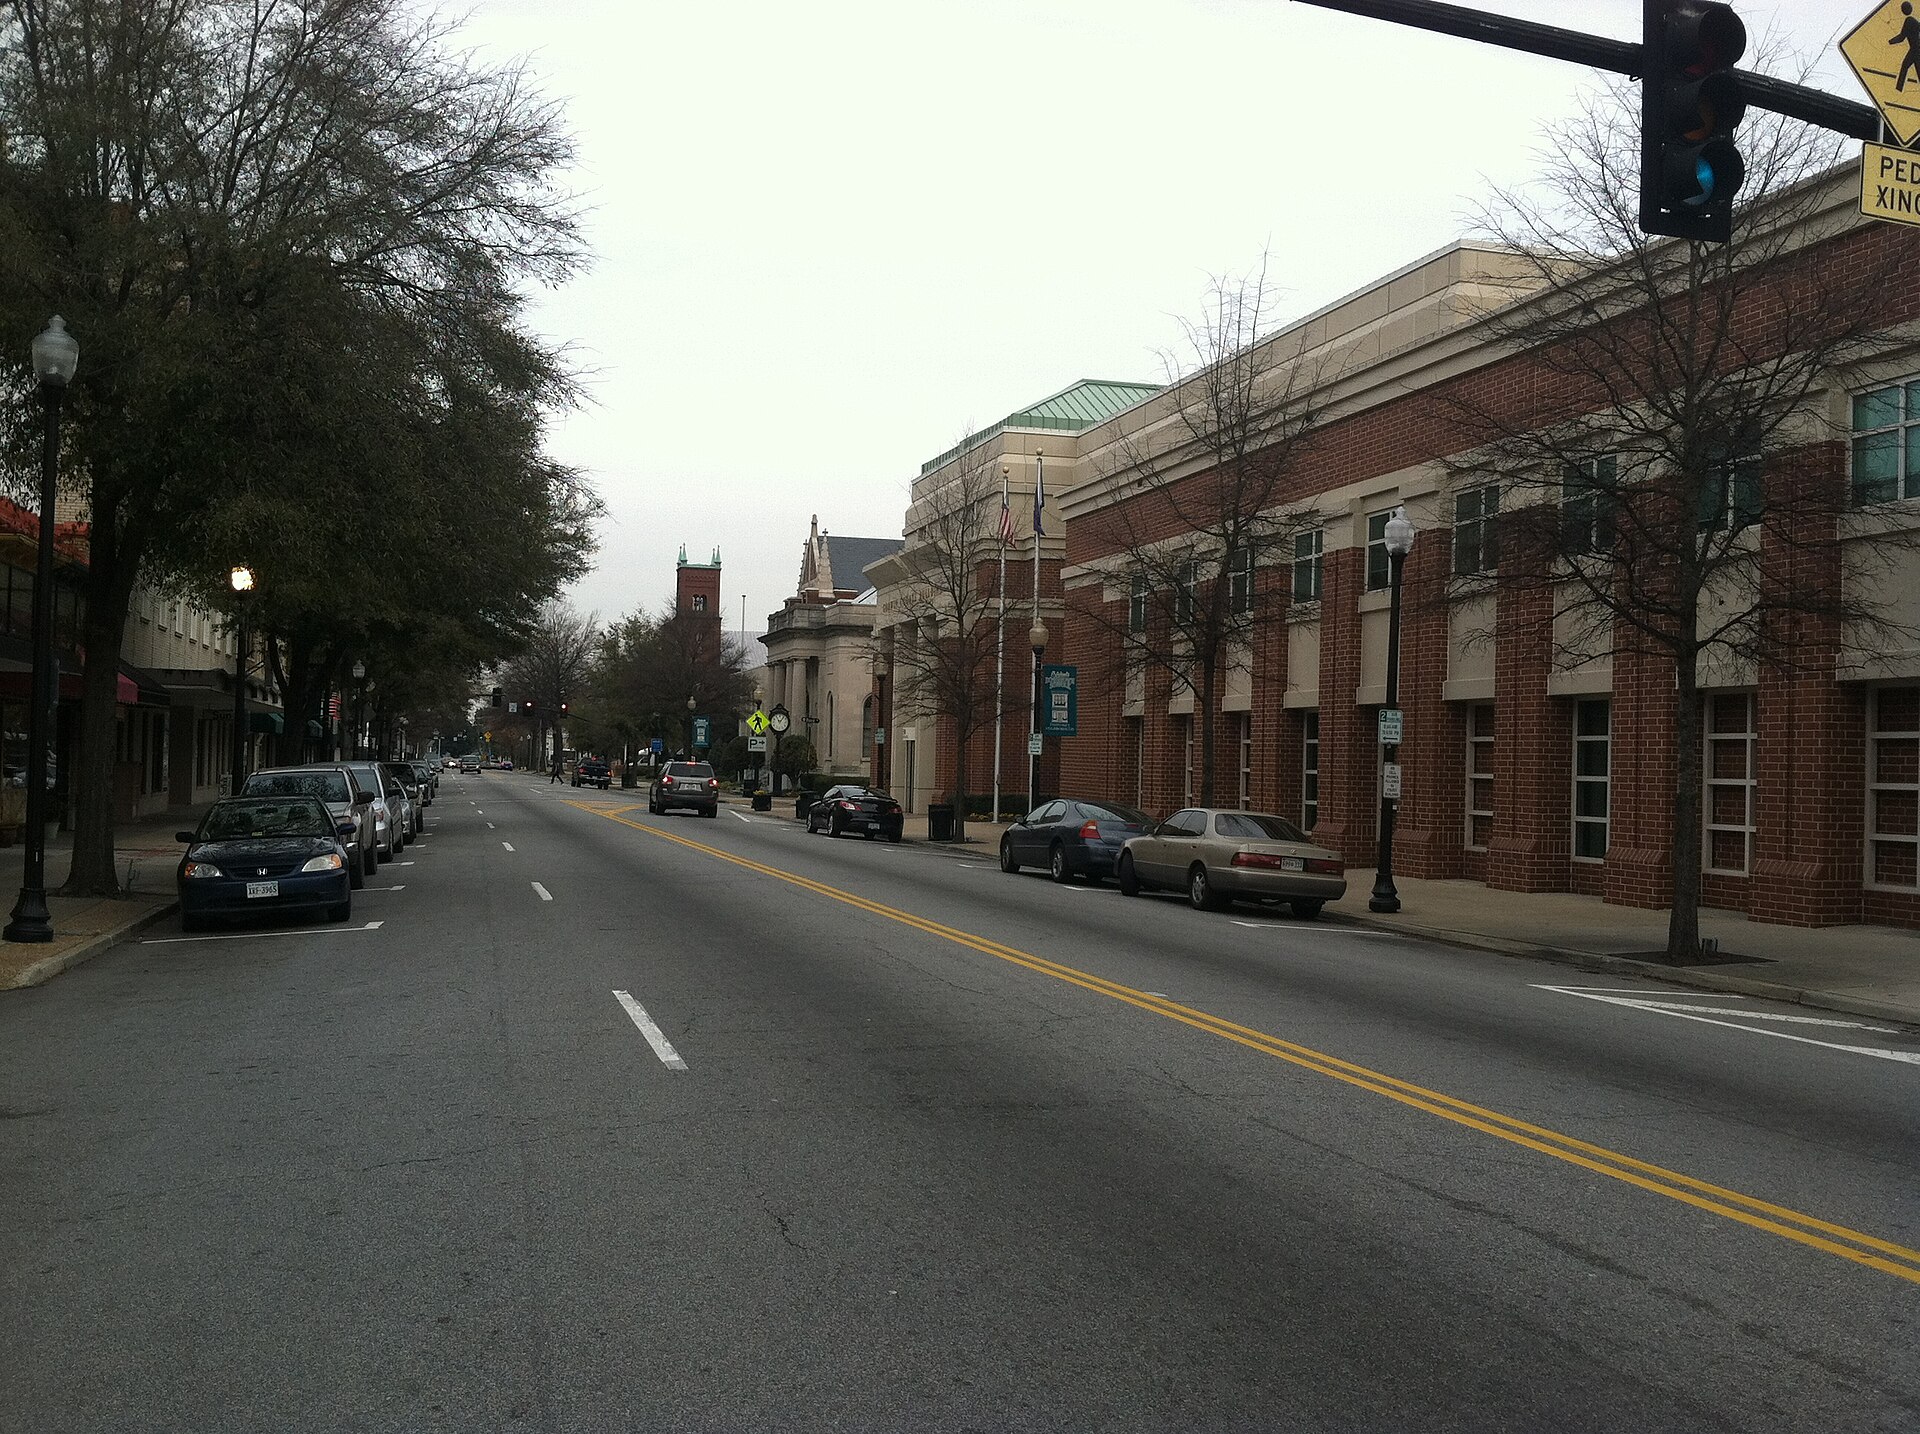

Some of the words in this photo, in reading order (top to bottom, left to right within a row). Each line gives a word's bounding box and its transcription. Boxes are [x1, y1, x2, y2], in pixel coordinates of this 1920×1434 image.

[1880, 155, 1920, 184] PED
[1381, 711, 1386, 721] 2
[750, 739, 758, 749] P
